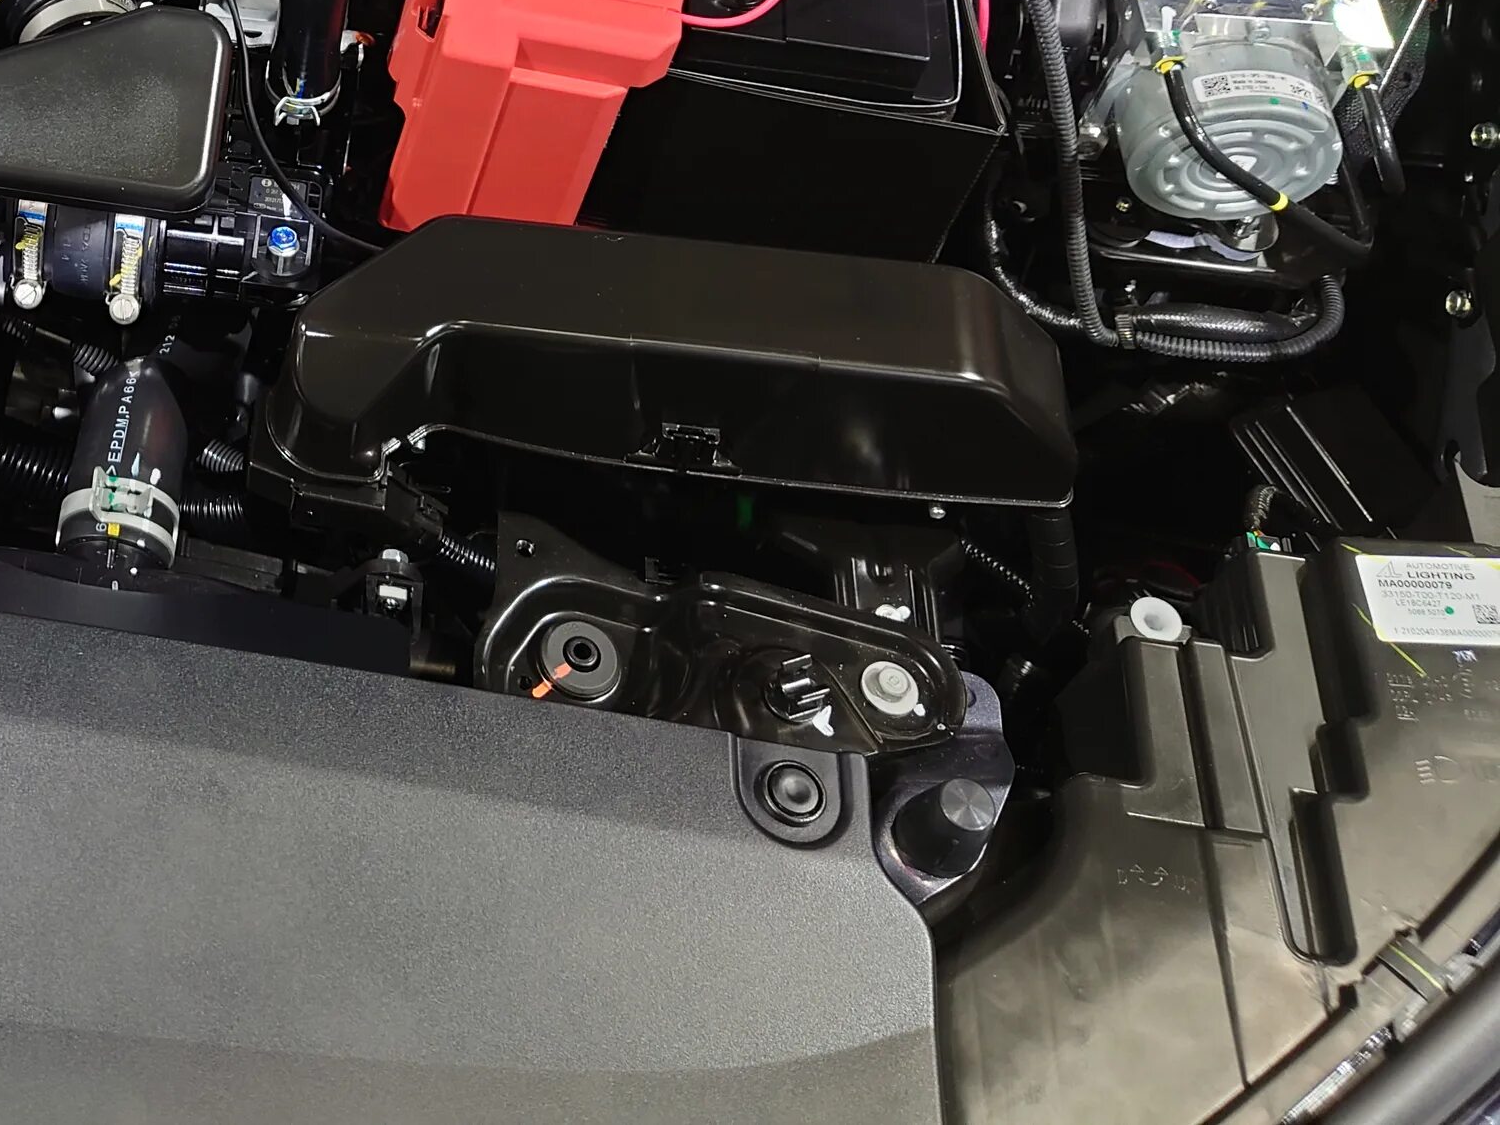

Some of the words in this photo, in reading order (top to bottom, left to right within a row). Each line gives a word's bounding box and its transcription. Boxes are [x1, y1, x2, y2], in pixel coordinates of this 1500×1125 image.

[159, 334, 176, 355] 212
[1406, 562, 1471, 571] AUTOMOTIVE
[1407, 571, 1476, 581] LIGHTING
[1378, 579, 1453, 590] MA00000079
